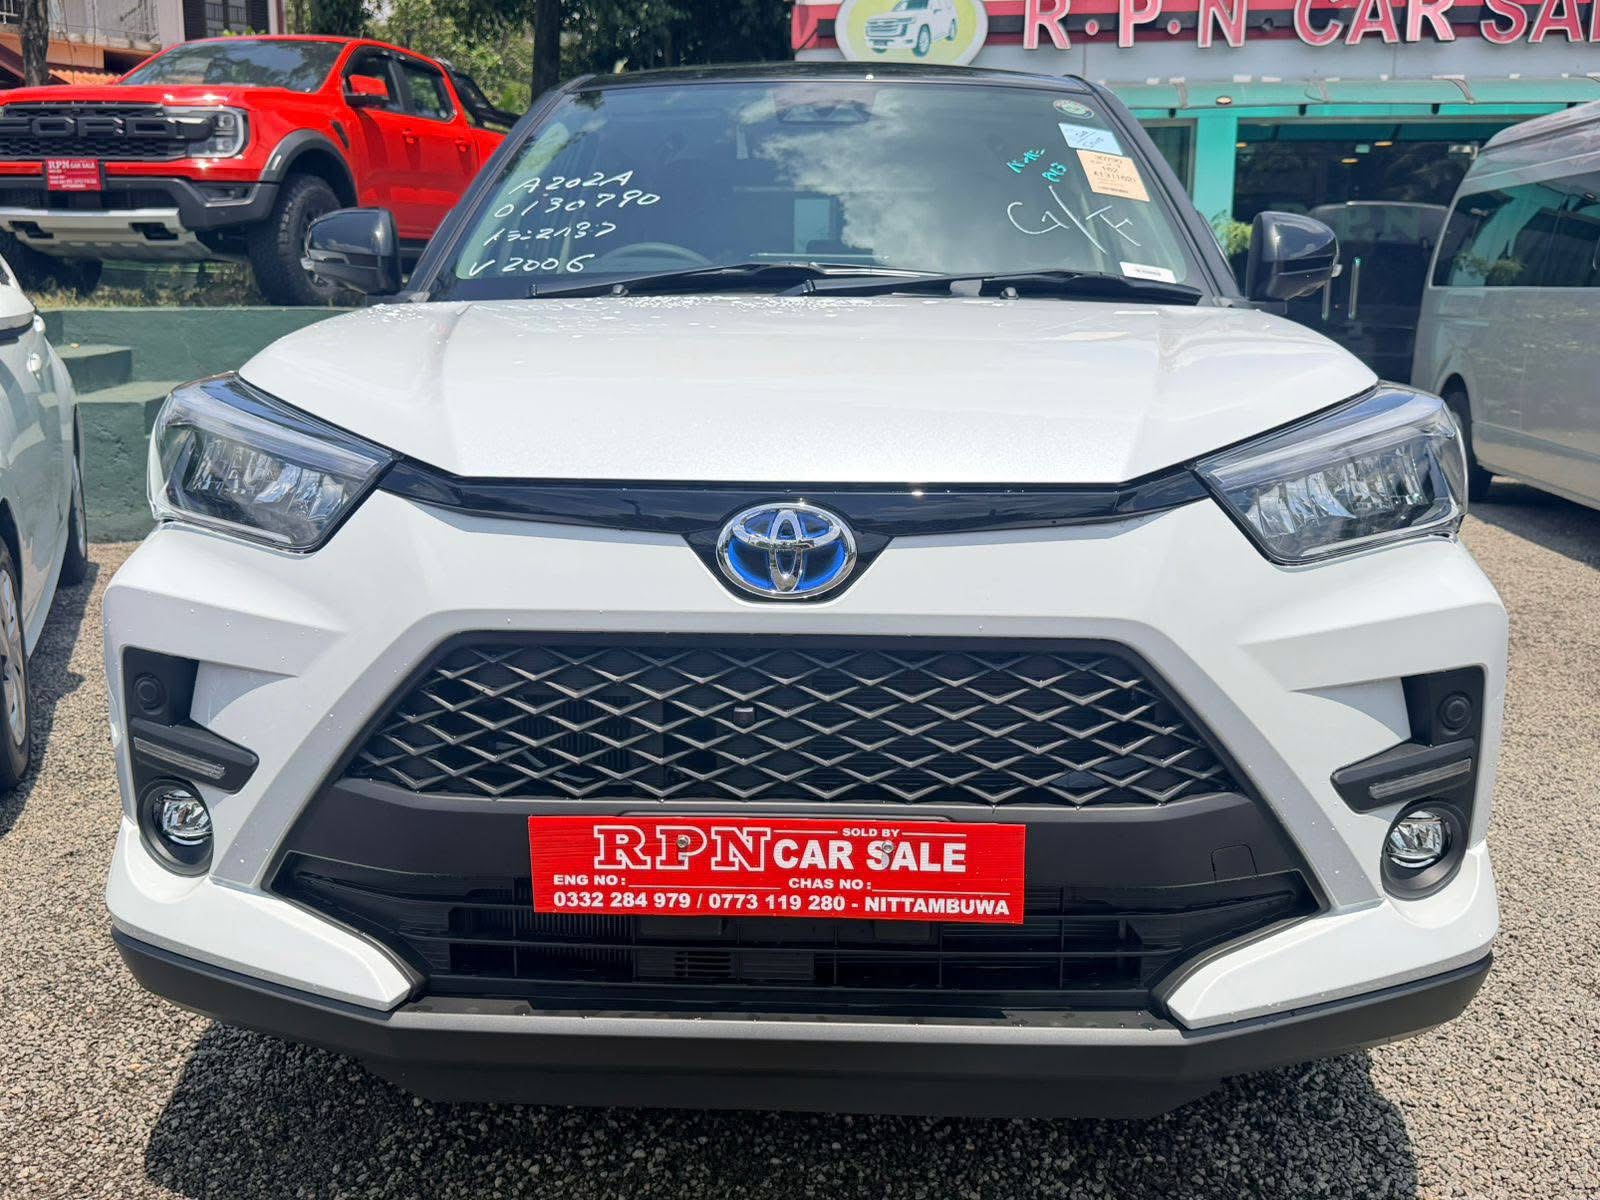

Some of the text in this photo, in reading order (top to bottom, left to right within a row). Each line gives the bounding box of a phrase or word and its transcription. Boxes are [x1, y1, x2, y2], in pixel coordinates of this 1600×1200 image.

[1293, 0, 1456, 46] CAR
[842, 828, 900, 838] SOLD BY
[593, 825, 967, 873] RPN CAR SALE
[553, 874, 589, 886] ENG
[788, 877, 834, 889] CHAS
[553, 891, 604, 908] 0332
[610, 892, 648, 908] 284
[654, 893, 691, 909] 979
[696, 893, 703, 909] /
[708, 893, 758, 910] 0773
[765, 894, 802, 911] 119
[807, 895, 846, 912] 280
[864, 897, 1010, 915] NITTAMBUWA
